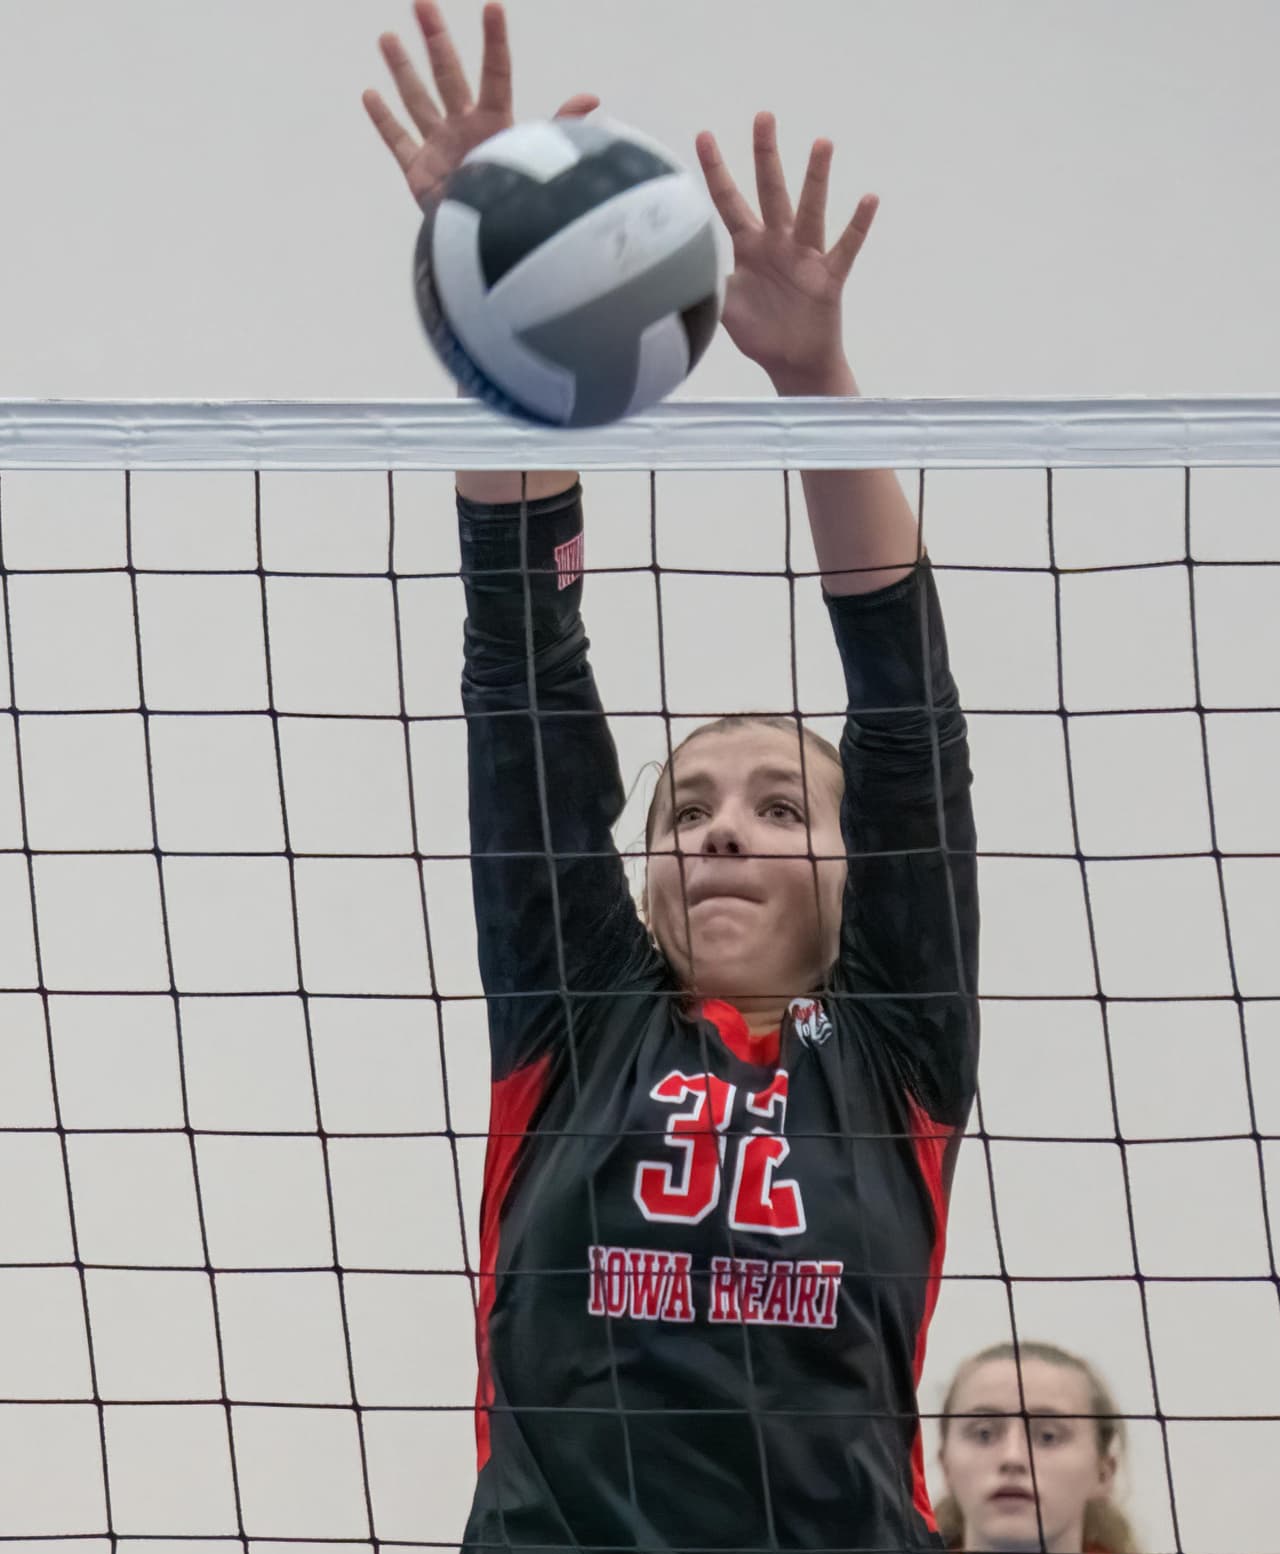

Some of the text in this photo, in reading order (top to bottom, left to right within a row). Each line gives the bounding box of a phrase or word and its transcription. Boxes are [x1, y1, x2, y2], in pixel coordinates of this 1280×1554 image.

[633, 1069, 807, 1236] 32
[588, 1246, 844, 1329] IOWA HEART
